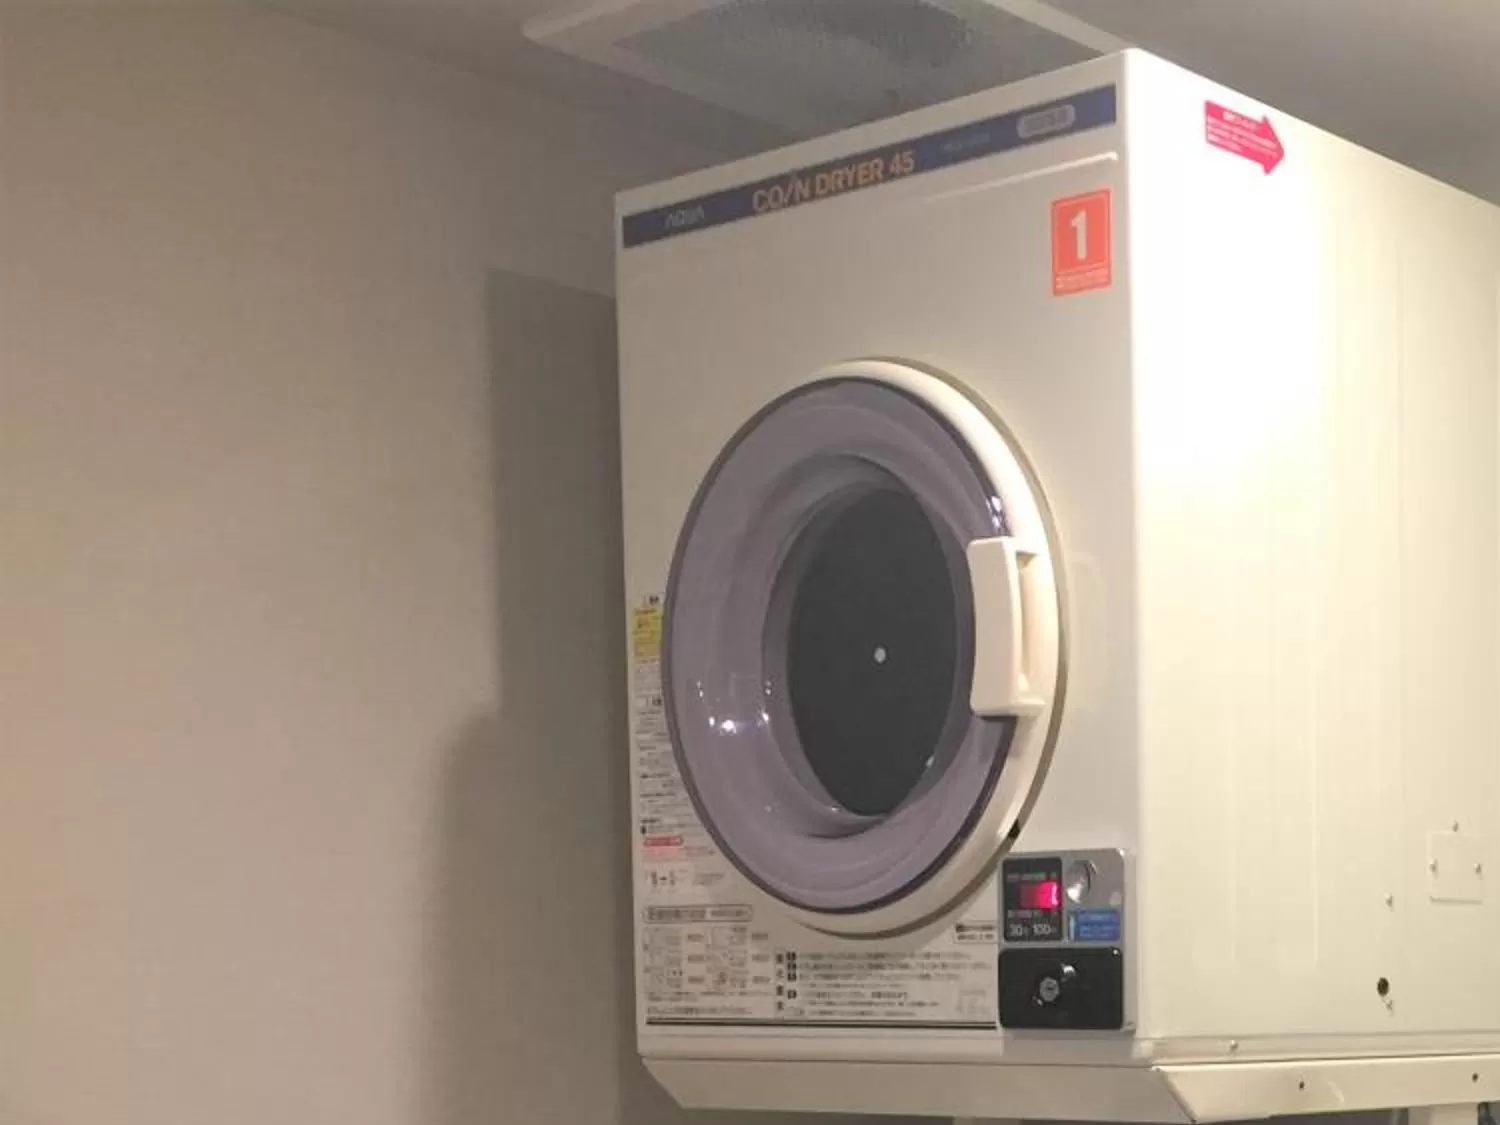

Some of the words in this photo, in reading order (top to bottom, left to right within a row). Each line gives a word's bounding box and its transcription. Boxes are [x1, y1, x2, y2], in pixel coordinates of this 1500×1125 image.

[815, 157, 884, 196] DRYER
[889, 151, 915, 176] 45
[1071, 210, 1087, 260] 1
